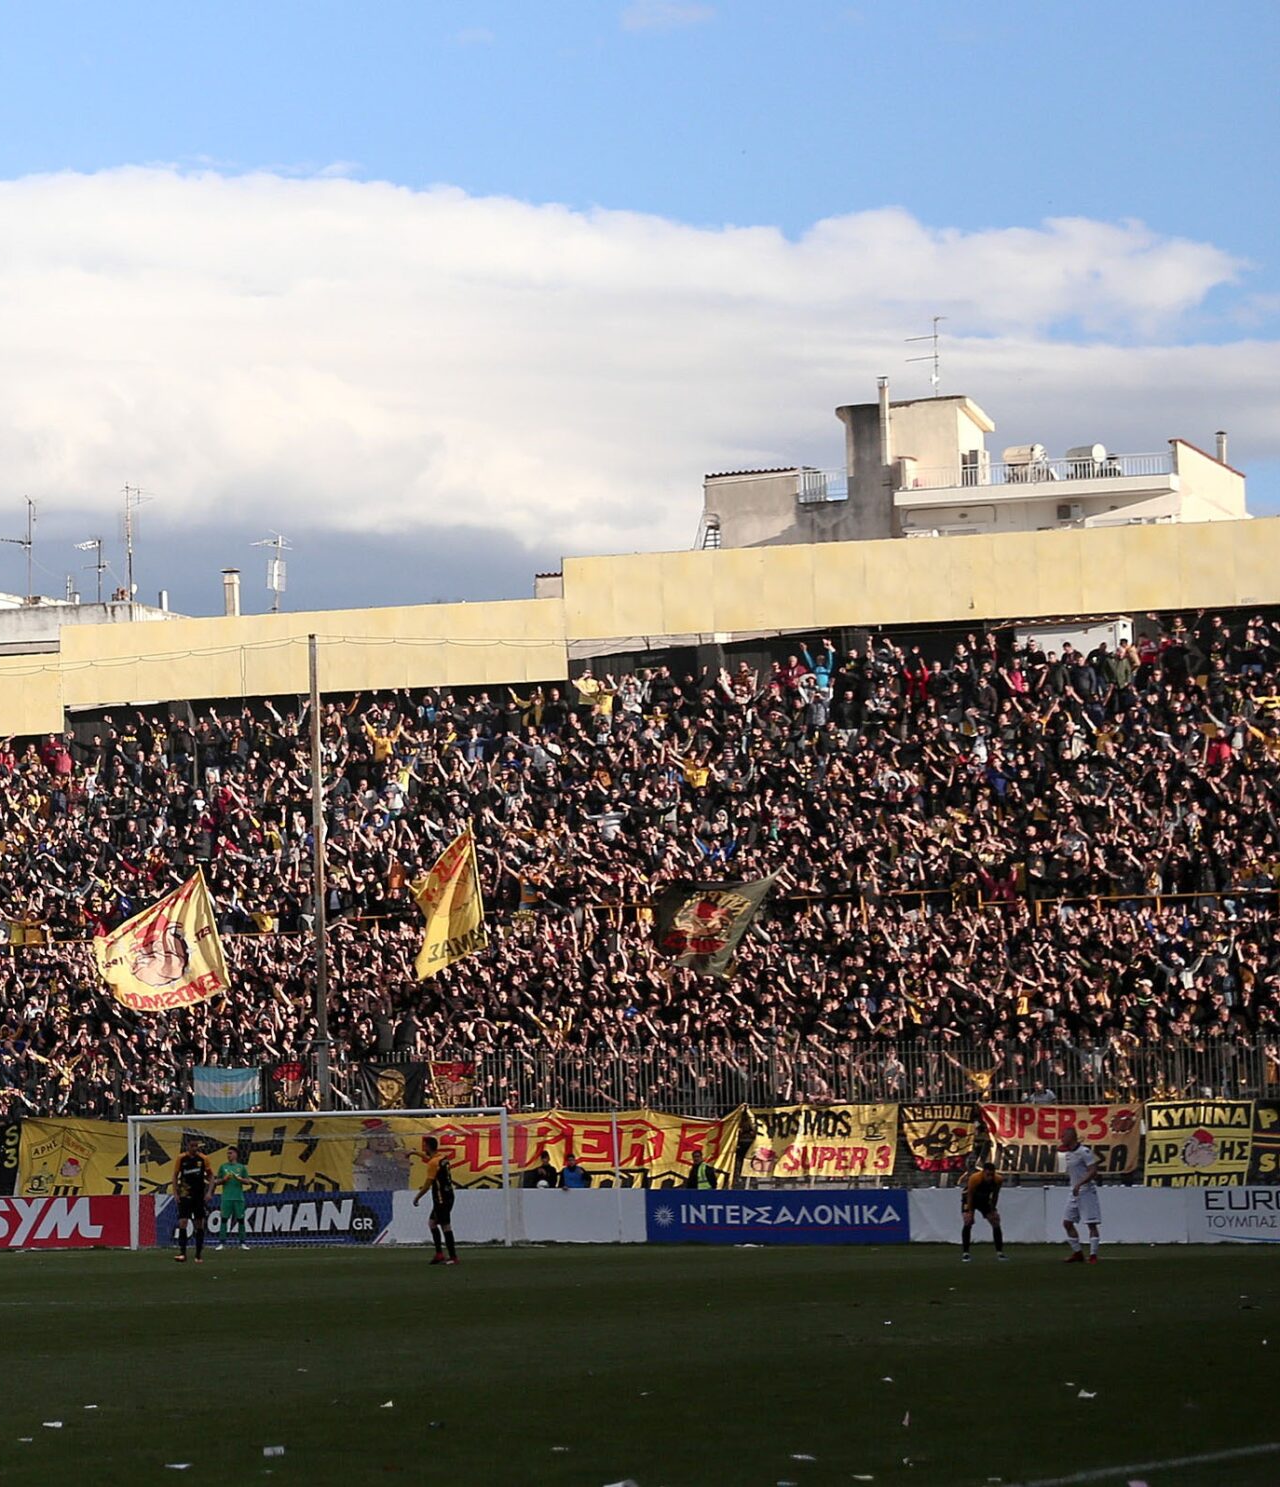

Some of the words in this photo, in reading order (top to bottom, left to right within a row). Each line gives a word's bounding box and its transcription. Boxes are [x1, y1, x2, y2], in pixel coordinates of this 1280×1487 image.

[754, 1109, 851, 1139] EVOSMOS
[783, 1145, 869, 1172] SUPER
[874, 1145, 892, 1170] 3
[681, 1204, 901, 1225] ΙΝΤΕΡΣΑΛΟΝΙΚΑ
[1206, 1215, 1277, 1228] ΤΟΥΜΠΑΣ
